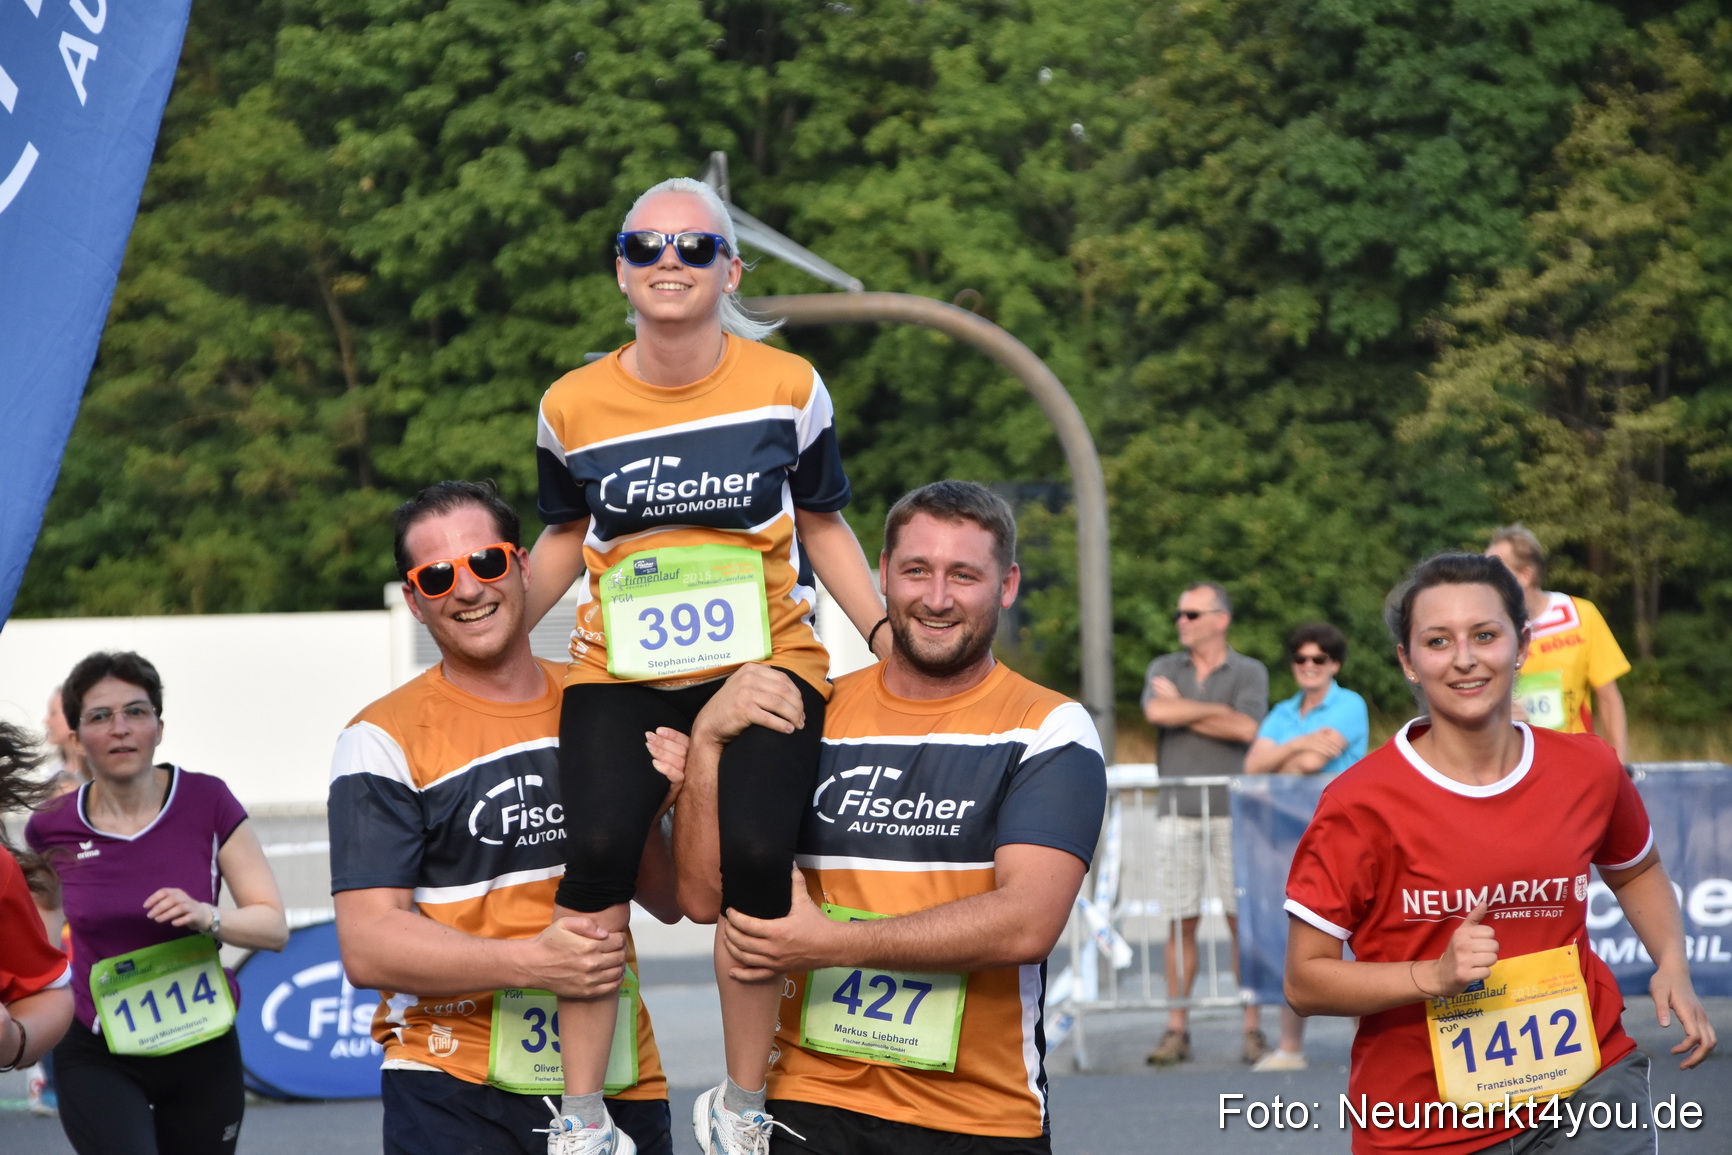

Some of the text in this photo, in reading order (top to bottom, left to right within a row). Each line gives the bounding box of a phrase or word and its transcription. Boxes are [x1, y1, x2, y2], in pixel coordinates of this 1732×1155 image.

[626, 471, 760, 505] Fischer
[641, 496, 753, 518] AUTOMOBILE
[625, 568, 681, 586] firmenlauf
[638, 598, 735, 651] 399
[647, 651, 732, 669] Stephanie Ainouz
[837, 789, 976, 820] Fischer
[501, 803, 566, 835] Fisc
[847, 820, 961, 836] AUTOMOBILE
[1402, 877, 1569, 915] NEUMARKT
[1494, 909, 1564, 919] STARKE STADT
[114, 972, 217, 1032] 1114
[832, 969, 933, 1026] 427
[138, 1033, 160, 1046] Birgit
[160, 1016, 208, 1037] Mühlenbruch
[834, 1023, 919, 1047] Markus Liebhardt
[1439, 1023, 1459, 1034] run
[842, 1037, 861, 1045] Fischer
[861, 1041, 890, 1050] Automobile
[890, 1045, 906, 1053] GmbH
[1451, 1008, 1583, 1074] 1412
[534, 1063, 560, 1073] Oliver
[1476, 1067, 1568, 1092] Franziska Spangler
[1519, 1085, 1544, 1094] Neumarkt
